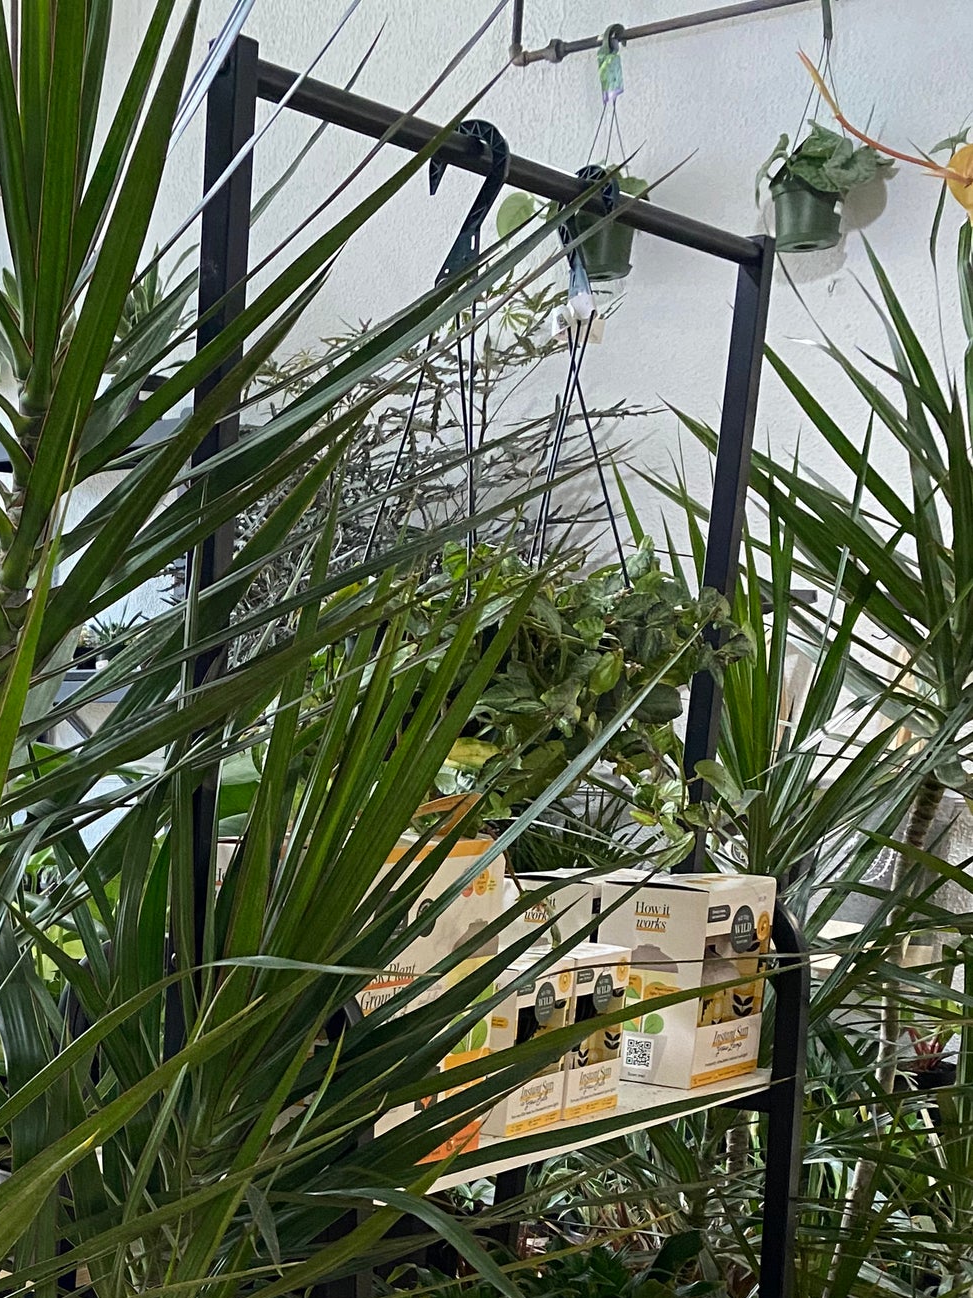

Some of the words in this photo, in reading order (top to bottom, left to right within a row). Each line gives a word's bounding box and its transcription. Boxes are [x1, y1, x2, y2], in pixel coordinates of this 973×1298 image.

[635, 901, 660, 914] How
[662, 903, 671, 915] it
[636, 917, 667, 930] works
[734, 922, 753, 934] WILD
